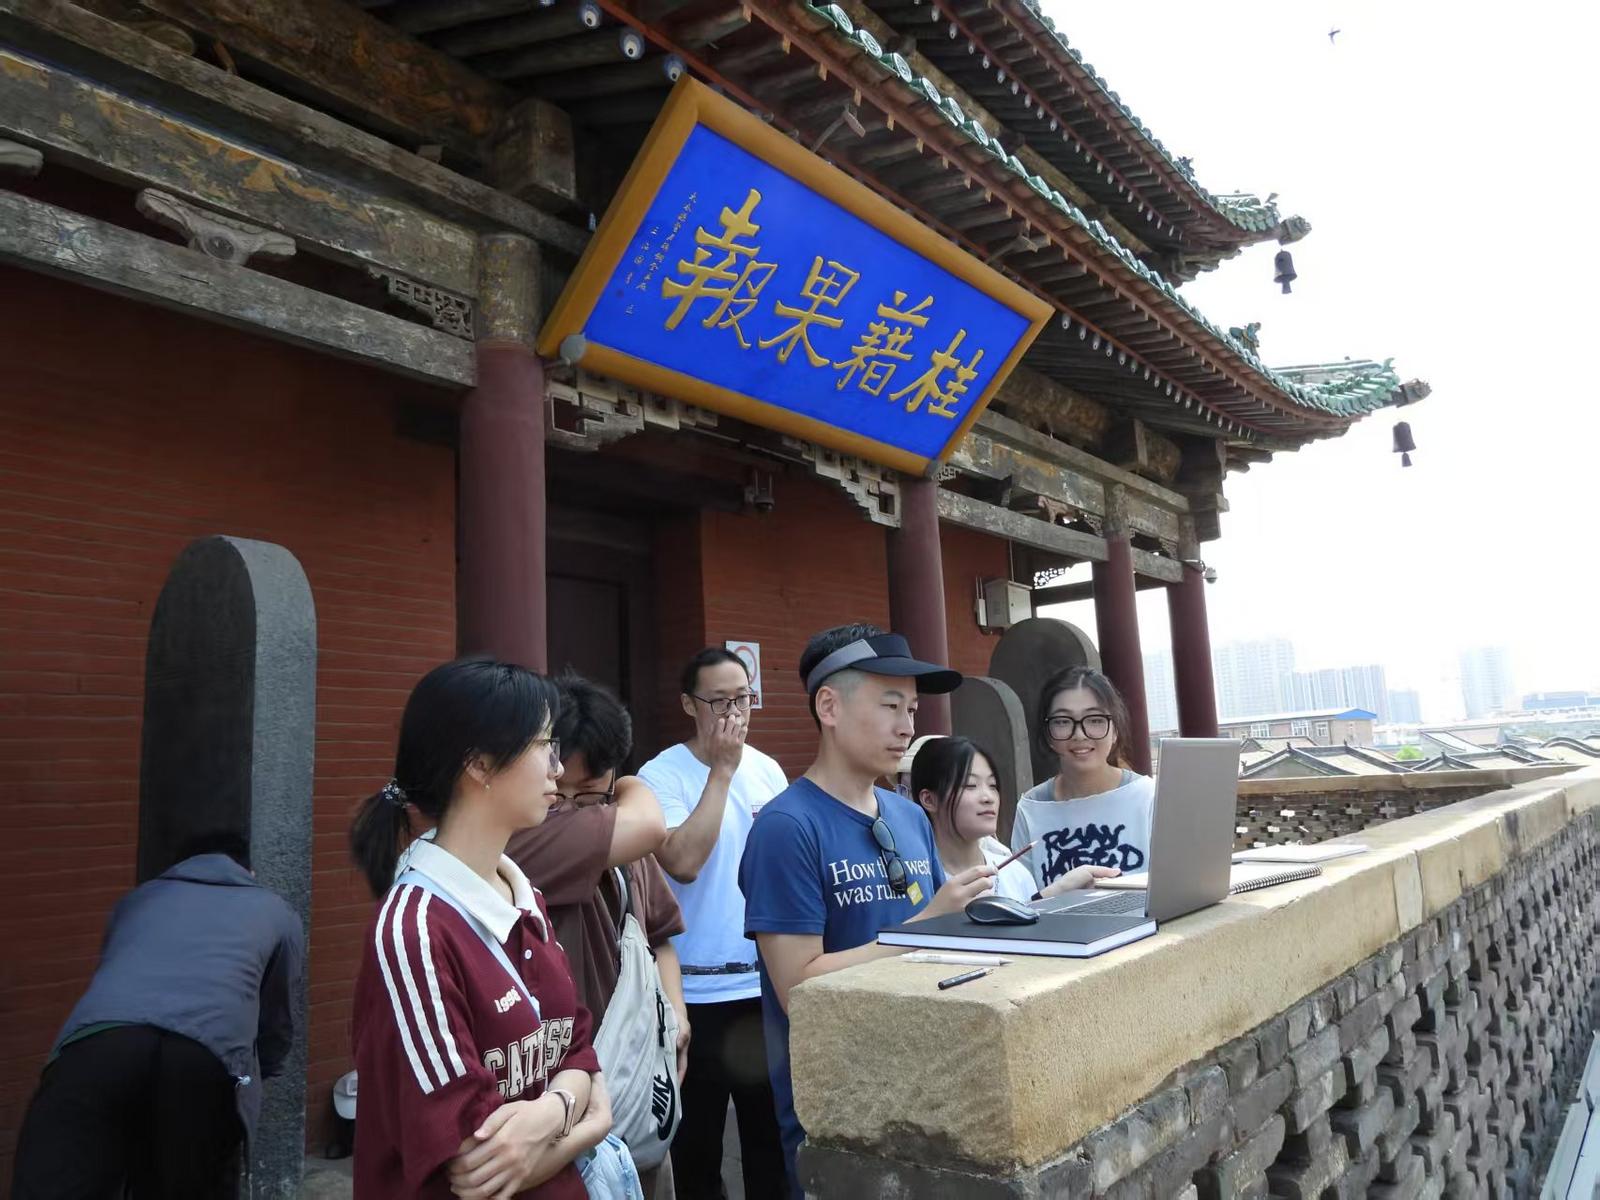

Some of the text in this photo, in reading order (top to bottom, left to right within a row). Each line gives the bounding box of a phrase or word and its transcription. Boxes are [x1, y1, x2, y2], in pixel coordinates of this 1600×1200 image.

[828, 859, 875, 887] How
[834, 885, 874, 908] was
[651, 1074, 671, 1125] NIKE
